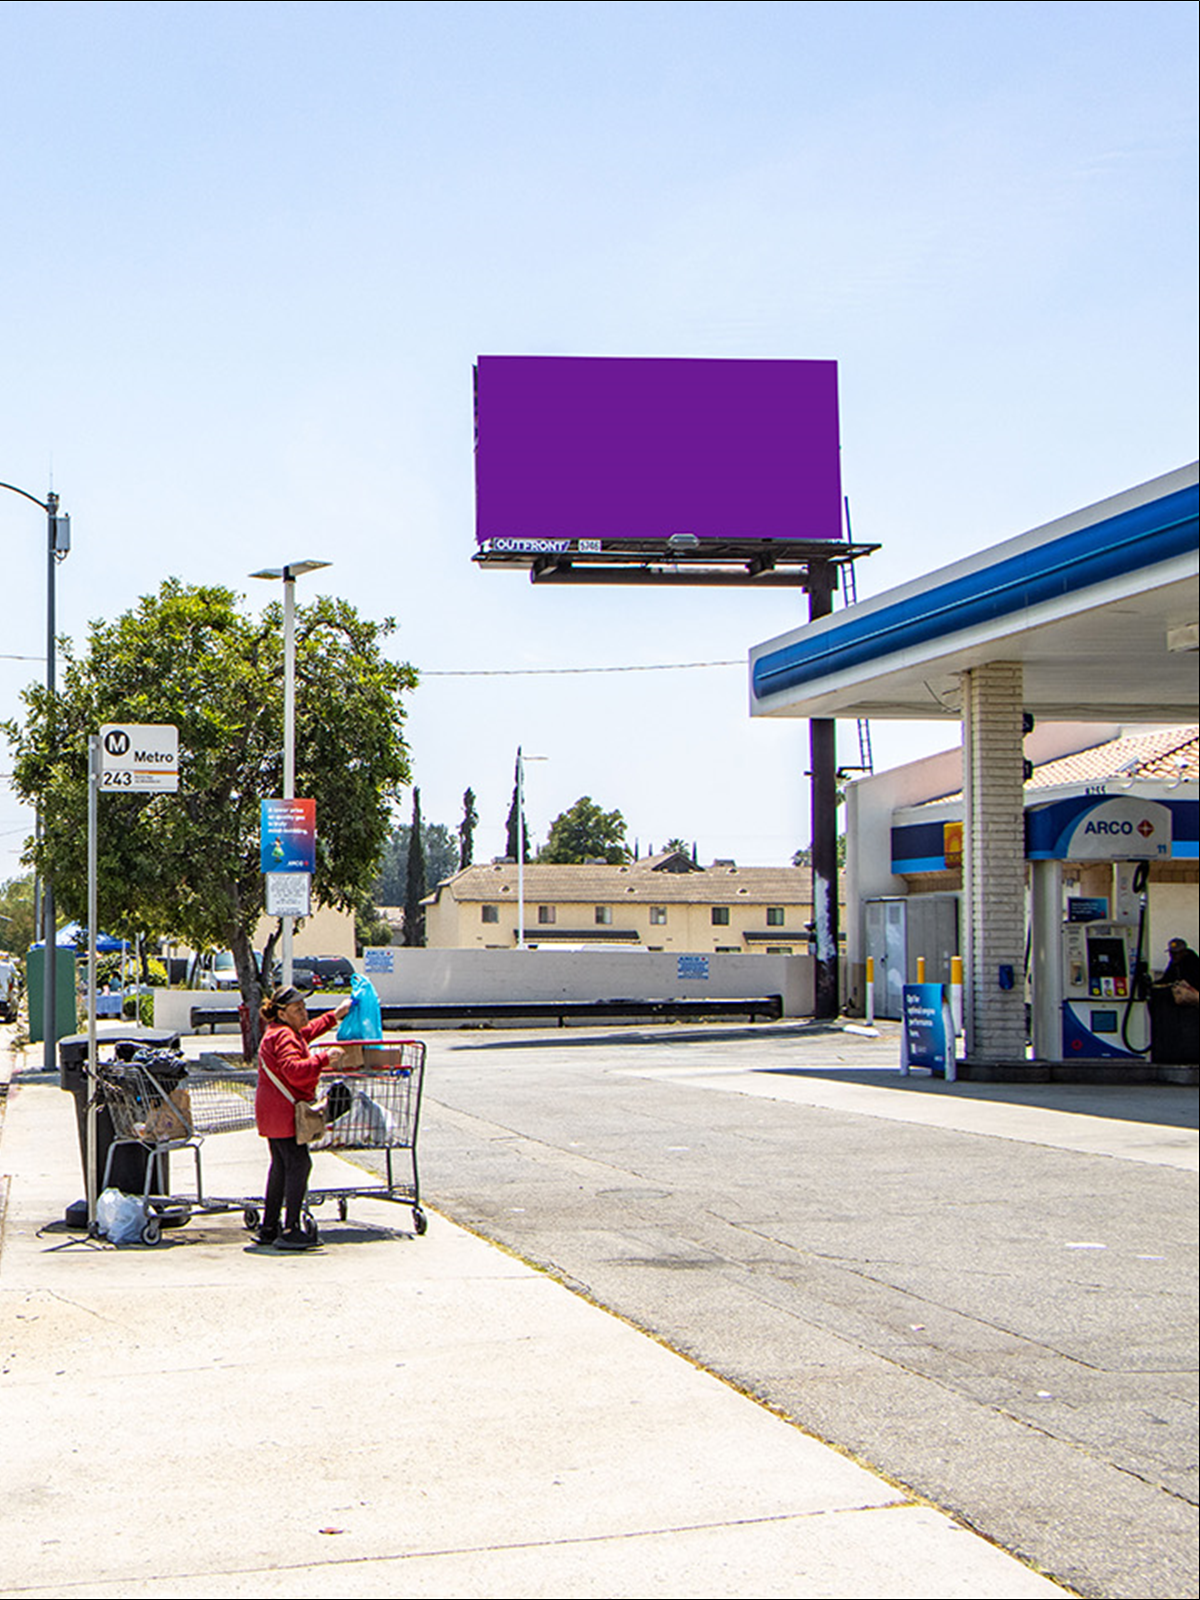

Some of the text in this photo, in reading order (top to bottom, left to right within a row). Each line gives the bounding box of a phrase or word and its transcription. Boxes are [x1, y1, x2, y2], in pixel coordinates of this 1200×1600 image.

[109, 734, 126, 752] M
[134, 751, 174, 763] Metro
[104, 771, 132, 786] 243
[1084, 821, 1133, 835] ARCO
[1157, 844, 1167, 854] 11
